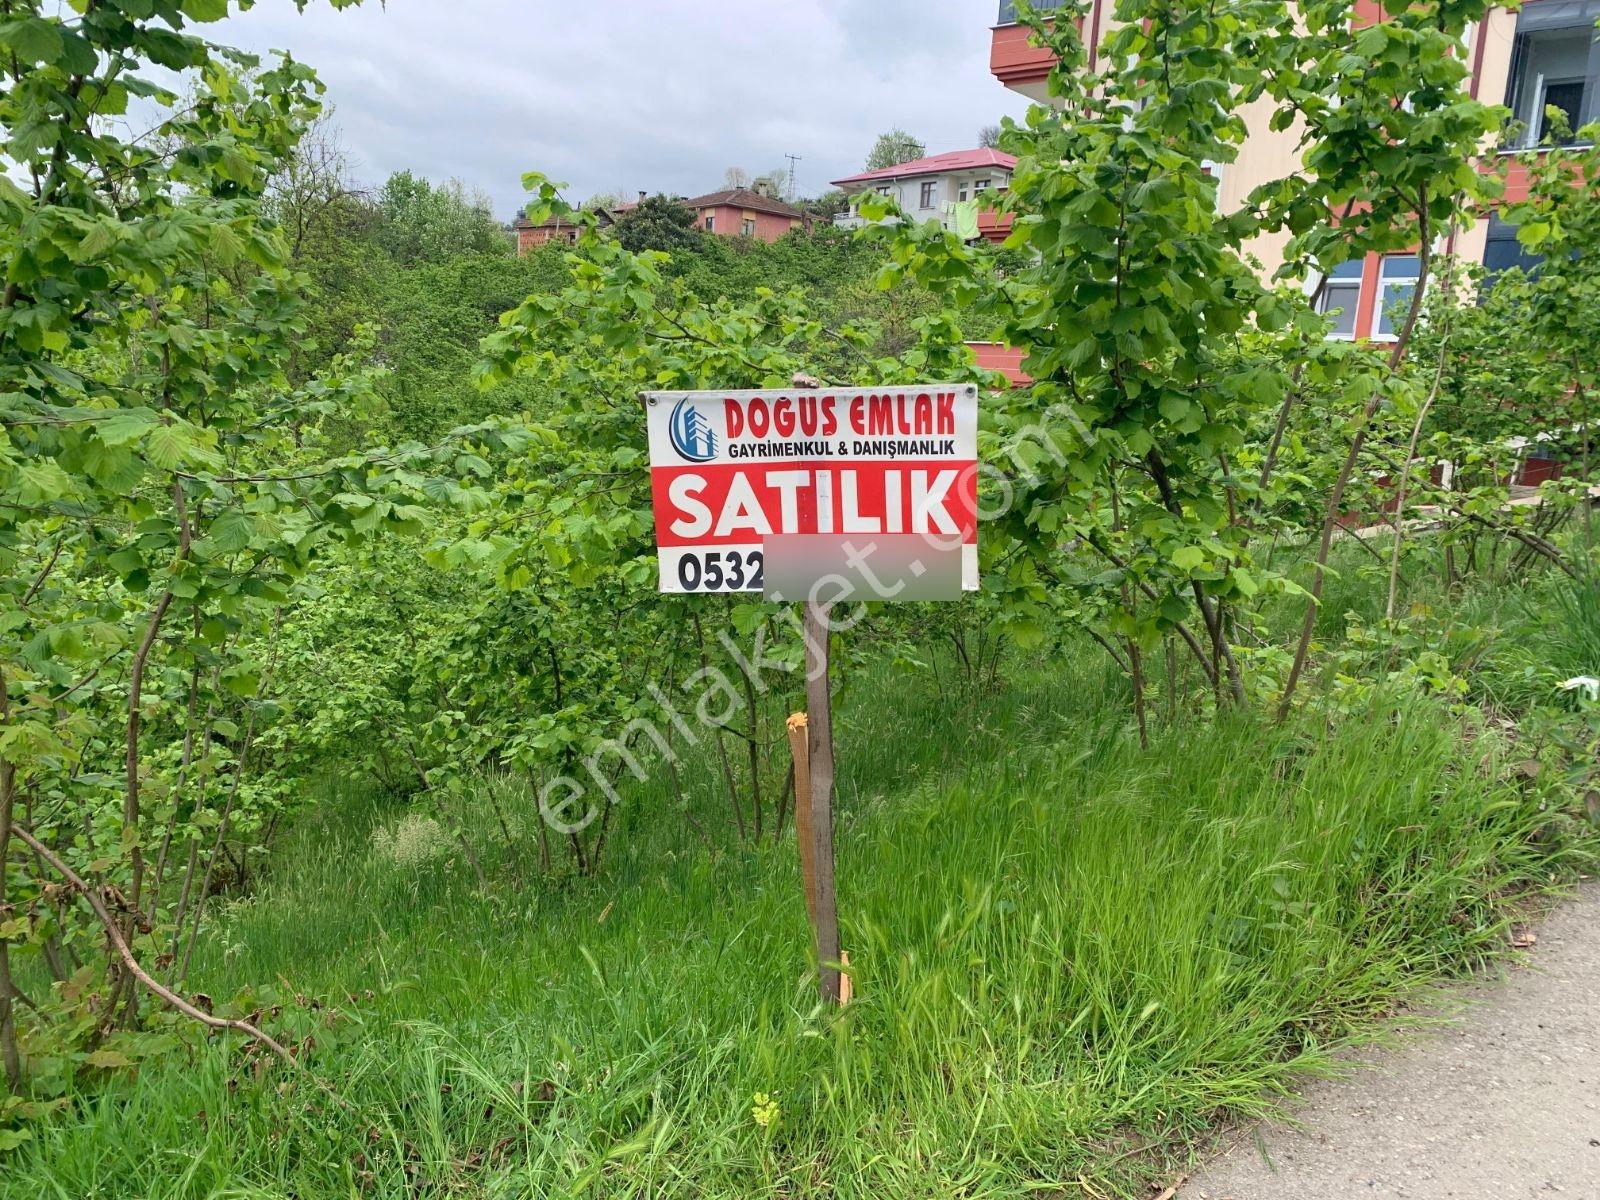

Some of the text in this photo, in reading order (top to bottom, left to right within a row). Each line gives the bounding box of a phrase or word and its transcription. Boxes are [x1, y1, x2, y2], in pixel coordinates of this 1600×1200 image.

[850, 392, 956, 435] EMLAK
[728, 439, 955, 459] GAYRİMENKUL & DANIŞMANLIK
[668, 469, 961, 538] SATILIK
